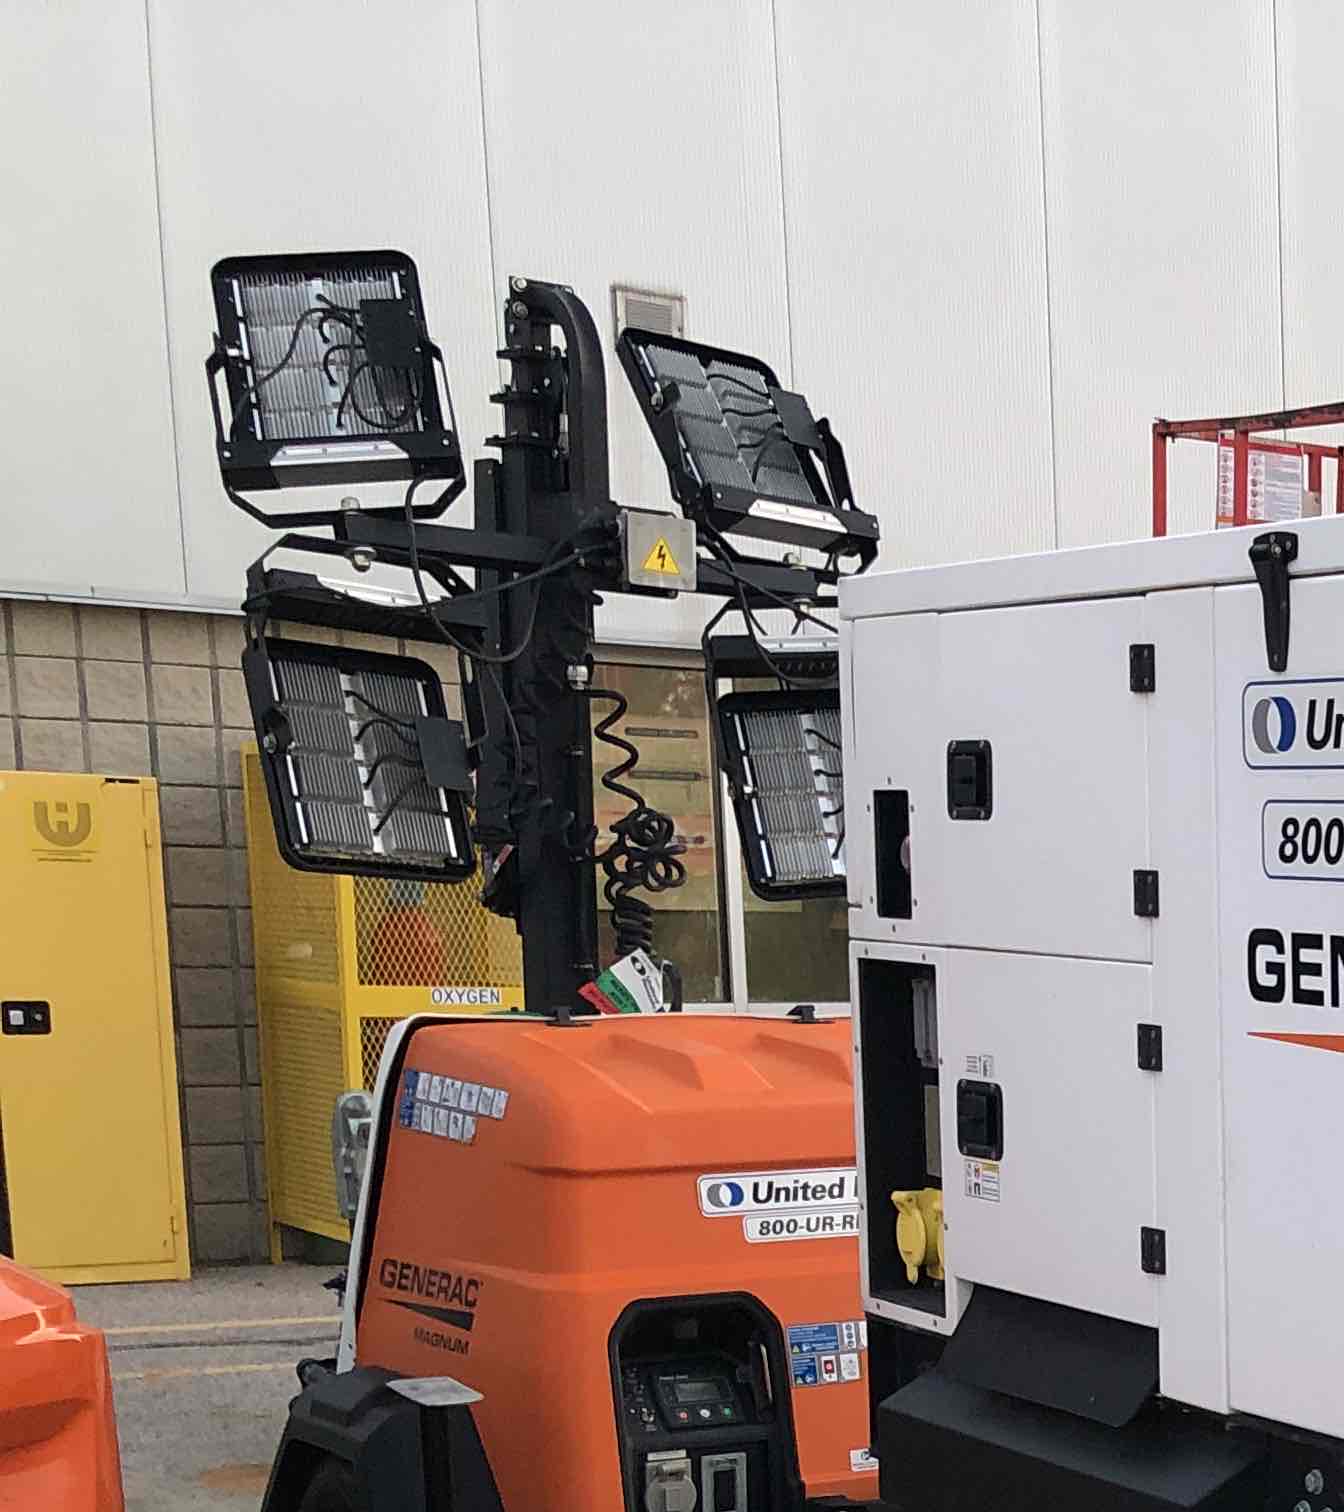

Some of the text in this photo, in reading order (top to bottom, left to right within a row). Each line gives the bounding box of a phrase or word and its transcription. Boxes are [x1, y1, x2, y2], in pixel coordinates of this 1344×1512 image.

[431, 988, 501, 1004] OXYGEN
[752, 1176, 846, 1205] United
[380, 1258, 480, 1308] GENERAC
[414, 1327, 470, 1355] MAGNUM
